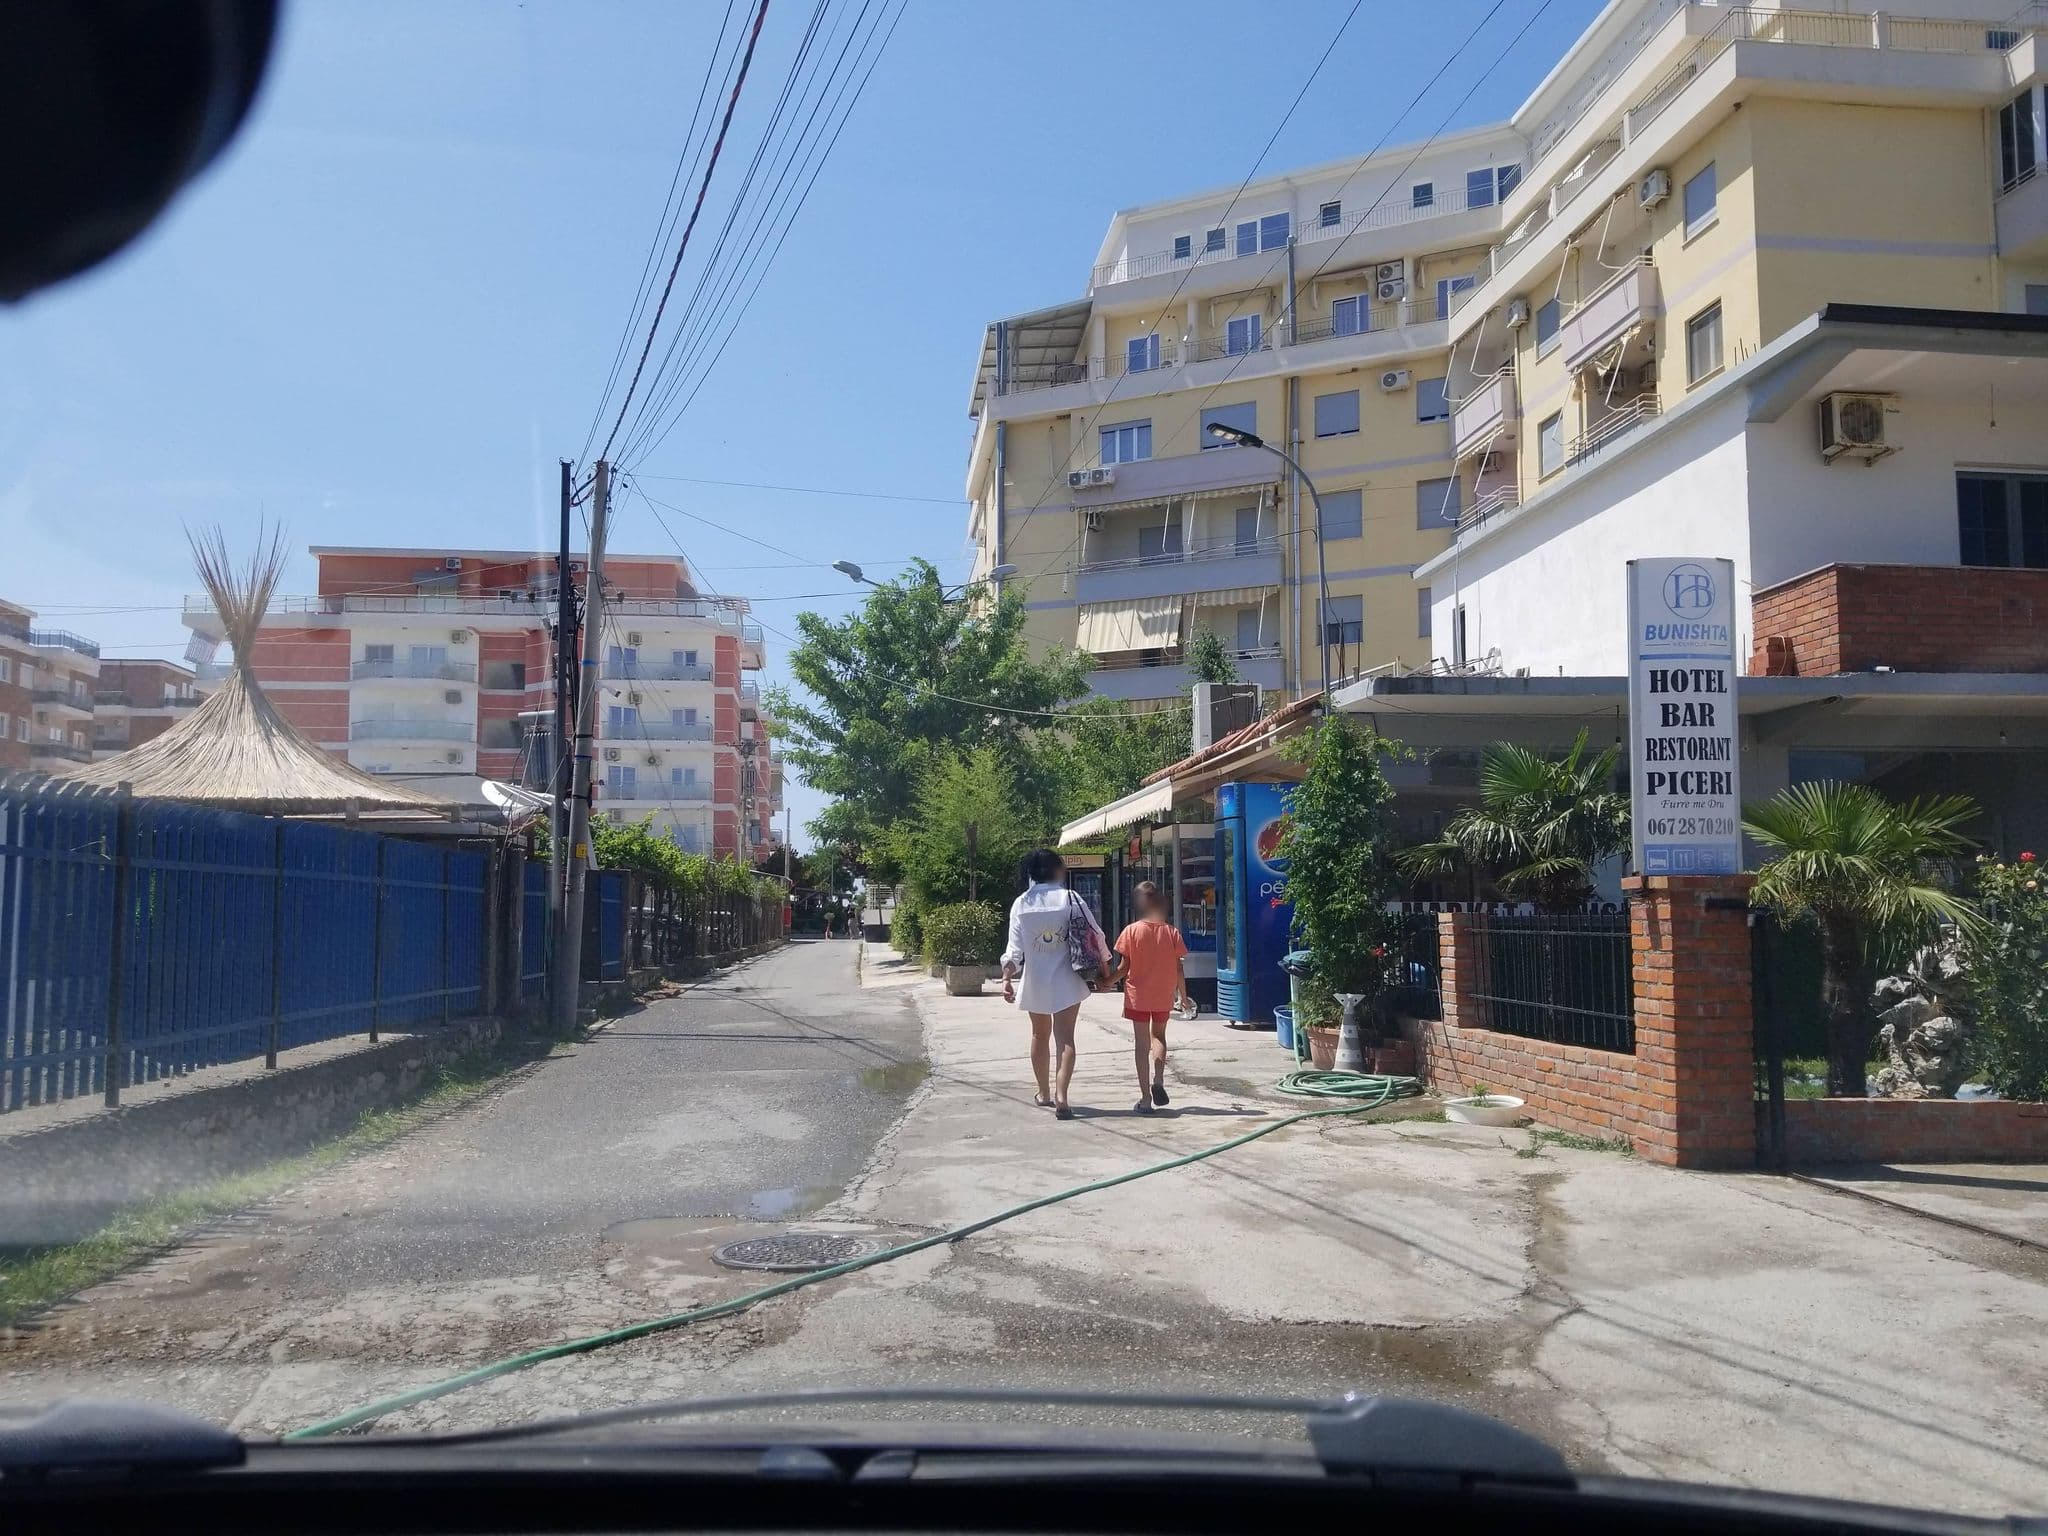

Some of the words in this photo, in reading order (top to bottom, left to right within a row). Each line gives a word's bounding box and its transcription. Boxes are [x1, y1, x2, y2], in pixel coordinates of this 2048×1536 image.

[1645, 623, 1728, 641] BUNISHTA
[1649, 668, 1728, 693] HOTEL
[1660, 702, 1715, 727] BAR
[1645, 737, 1732, 761] RESTORANT
[1646, 771, 1733, 796] PICERI
[1692, 801, 1706, 809] me
